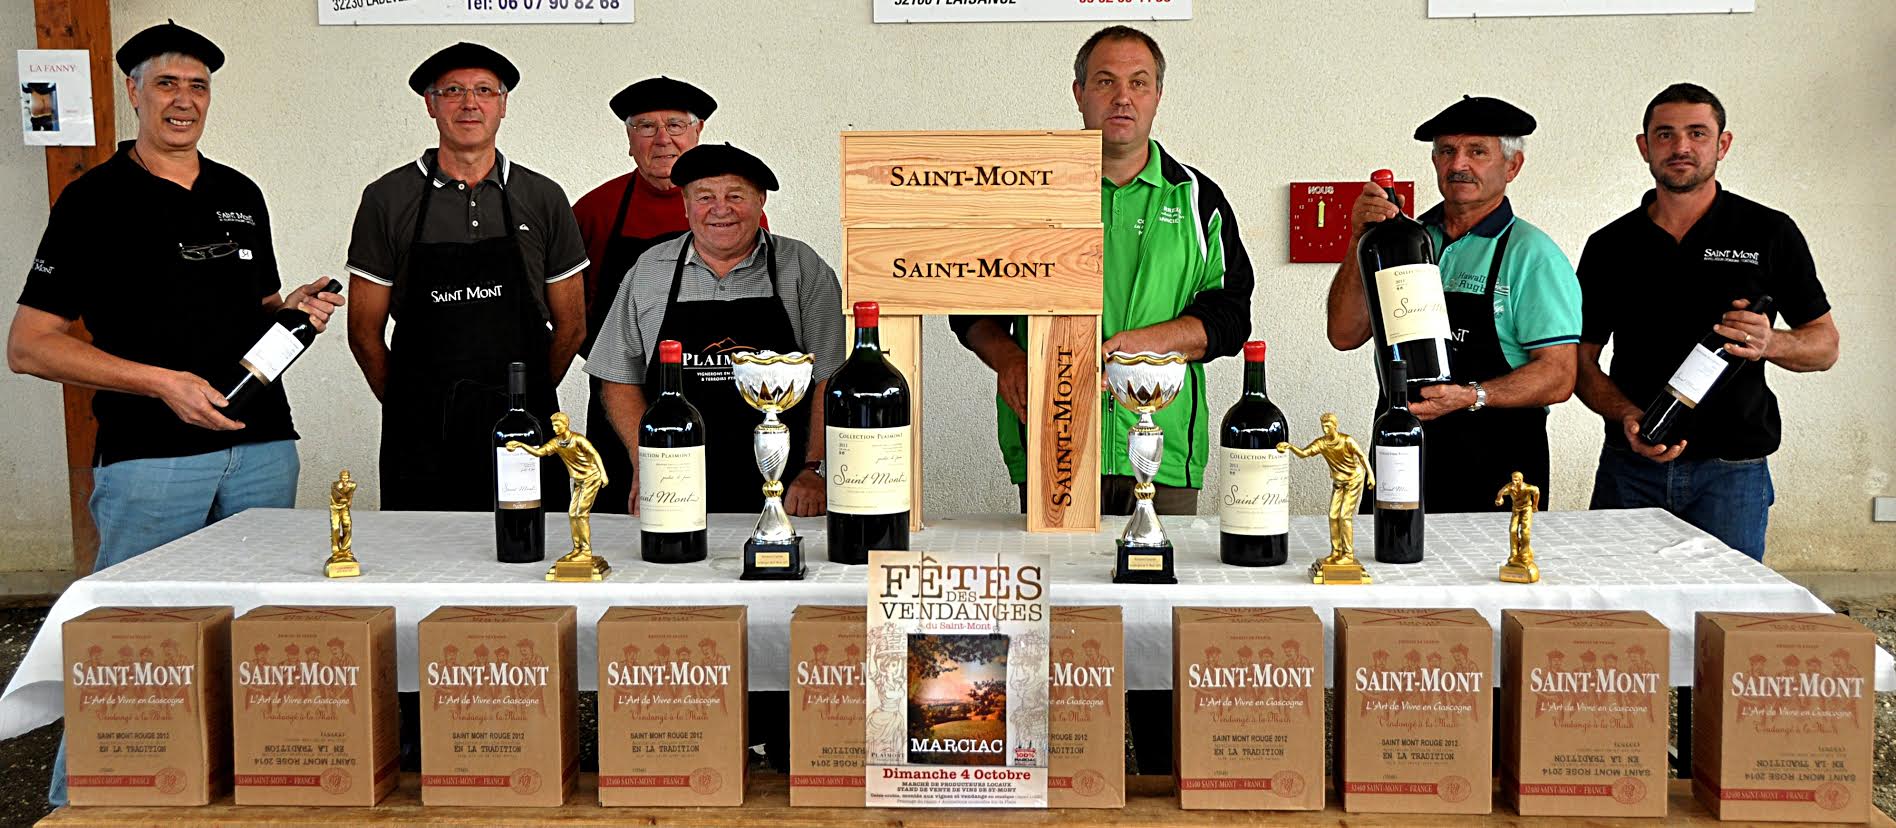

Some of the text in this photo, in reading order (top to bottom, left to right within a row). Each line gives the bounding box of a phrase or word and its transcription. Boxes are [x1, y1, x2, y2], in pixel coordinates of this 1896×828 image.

[890, 165, 1054, 188] SAINT-MONT
[1704, 248, 1731, 258] SAINT
[1732, 249, 1759, 261] MONT
[892, 257, 1056, 279] SAINT-MONT
[430, 284, 503, 303] SAINT MONT
[682, 352, 735, 366] PLAIM
[1052, 344, 1073, 507] SAINT-MONT
[838, 432, 875, 440] COLLECTION
[1229, 452, 1266, 460] COLLECTION
[833, 464, 907, 486] Saint Mont
[656, 490, 700, 503] Mont
[1224, 484, 1260, 506] Saint
[880, 556, 1042, 600] FÊTES
[946, 591, 977, 602] DES
[879, 601, 1042, 622] VENDANGES
[925, 621, 991, 630] du Saint-Mont
[73, 662, 195, 686] SAINT-MONT
[239, 661, 360, 686] SAINT-MONT
[427, 662, 550, 686] SAINT-MONT
[607, 661, 731, 686] SAINT-MONT
[797, 661, 866, 686] SAINT-
[1049, 662, 1115, 687] -MONT
[1188, 663, 1315, 688] SAINT-MONT
[1355, 667, 1483, 692] SAINT-MONT
[1530, 667, 1660, 693] SAINT-MONT
[1731, 671, 1865, 698] SAINT-MONT
[461, 697, 471, 705] de
[472, 697, 490, 705] Vivre
[503, 696, 539, 707] Gascogne
[641, 696, 651, 705] de
[653, 696, 671, 705] Vivre
[673, 698, 682, 706] en
[683, 695, 721, 707] Gascogne
[1066, 696, 1104, 709] Gascogne
[1223, 698, 1232, 706] de
[1234, 698, 1253, 706] Vivre
[1265, 697, 1304, 708] Gascogne
[1390, 702, 1399, 711] de
[1401, 702, 1420, 711] Vivre
[1422, 704, 1432, 712] en
[1433, 702, 1472, 713] Gascogne
[1564, 703, 1574, 712] de
[1576, 703, 1596, 712] Vivre
[1597, 705, 1607, 713] en
[1609, 702, 1648, 714] Gascogne
[452, 732, 525, 740] SAINT MONT ROUGE 2012
[630, 732, 703, 740] SAINT MONT ROUGE 2012
[1050, 733, 1073, 741] ROUGE
[632, 745, 700, 753] EN LA TRADITION
[910, 737, 1003, 753] MARCIAC
[1381, 739, 1458, 747] SAINT MONT ROUGE 2012
[1214, 748, 1284, 756] EN LA TRADITION
[1382, 752, 1454, 760] EN LA TRADITION
[833, 759, 858, 767] ROSE
[883, 768, 1031, 780] Dimanche 4 Octobre
[1565, 768, 1591, 776] ROSE
[1594, 768, 1621, 776] MONT
[1624, 768, 1650, 776] SAINT
